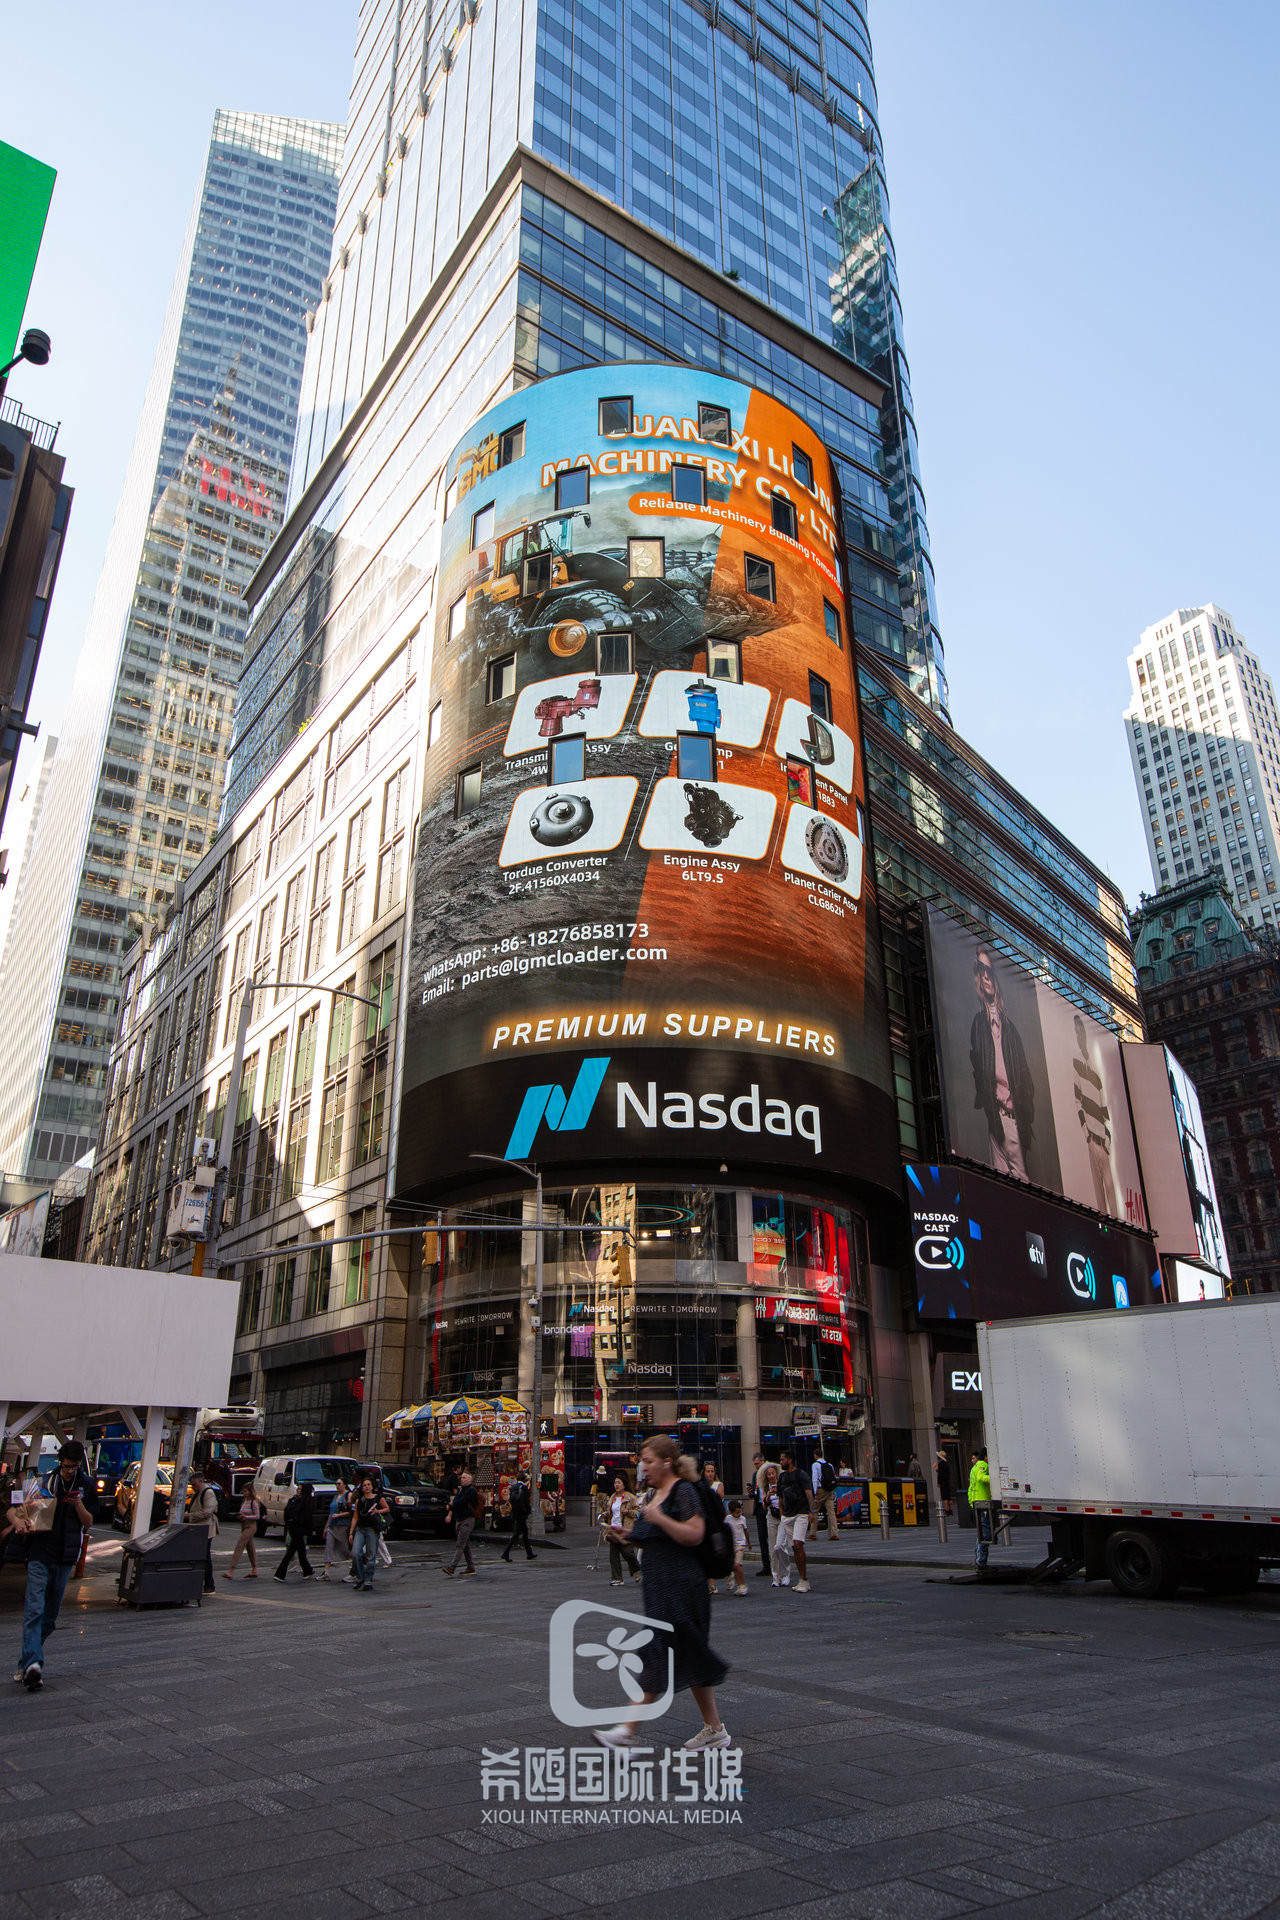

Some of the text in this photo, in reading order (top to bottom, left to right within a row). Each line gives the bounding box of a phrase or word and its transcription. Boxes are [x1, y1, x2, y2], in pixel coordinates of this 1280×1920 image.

[640, 498, 696, 511] Reliable
[700, 505, 767, 533] Machinery
[768, 525, 810, 559] Building
[502, 856, 608, 882] Tordue Converter
[663, 854, 741, 874] Engine Assy
[508, 870, 601, 895] 2F.41560X4034
[784, 872, 858, 915] Planet Carier Assy
[807, 894, 845, 918] CLG862H
[490, 922, 650, 956] +86-18276858173
[422, 945, 668, 1005] Email: parts@lgmcloader.com
[492, 1013, 837, 1057] PREMIUM SUPPLIERS
[616, 1081, 823, 1155] Nasdaq
[913, 1212, 959, 1224] NASDAQ:
[1124, 1186, 1145, 1228] H&M
[924, 1224, 951, 1233] CAST
[478, 1311, 513, 1322] TOMORROW
[583, 1304, 718, 1314] Nasdaq REWRITE TOMORROW
[544, 1323, 585, 1335] branded
[628, 1363, 673, 1376] Nasdaq
[836, 1487, 864, 1516] AMAZE
